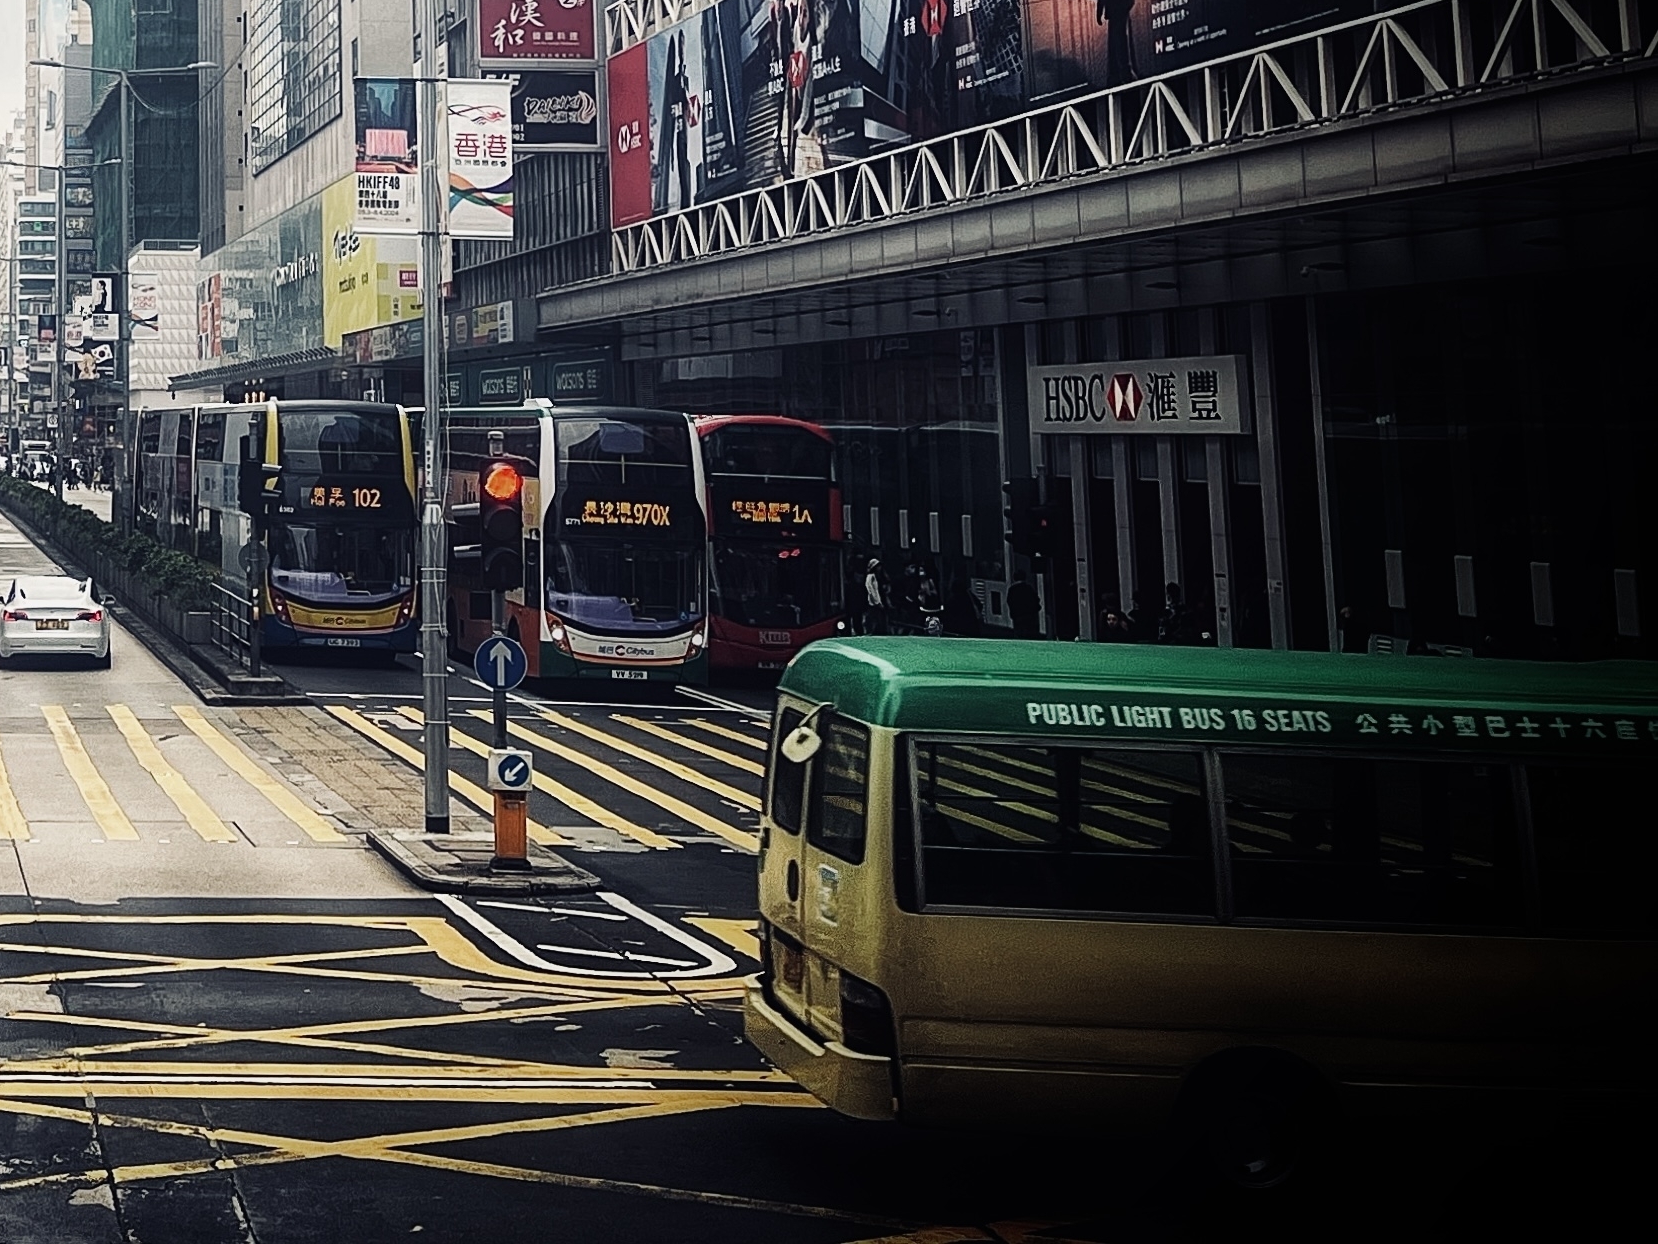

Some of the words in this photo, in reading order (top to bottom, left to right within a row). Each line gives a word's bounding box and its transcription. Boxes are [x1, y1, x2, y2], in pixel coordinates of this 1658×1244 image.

[454, 133, 508, 158] 香港
[358, 175, 400, 189] HKIFF48
[1043, 373, 1106, 422] HSBC
[352, 489, 381, 507] 102
[633, 504, 670, 526] 970X
[1027, 702, 1105, 726] PUBLIC
[1112, 706, 1172, 729] LIGHT
[1182, 708, 1226, 730] BUS
[1234, 710, 1256, 731] 16
[1265, 712, 1332, 733] SEATS
[1354, 712, 1658, 743] 公共小型巴士十六座
